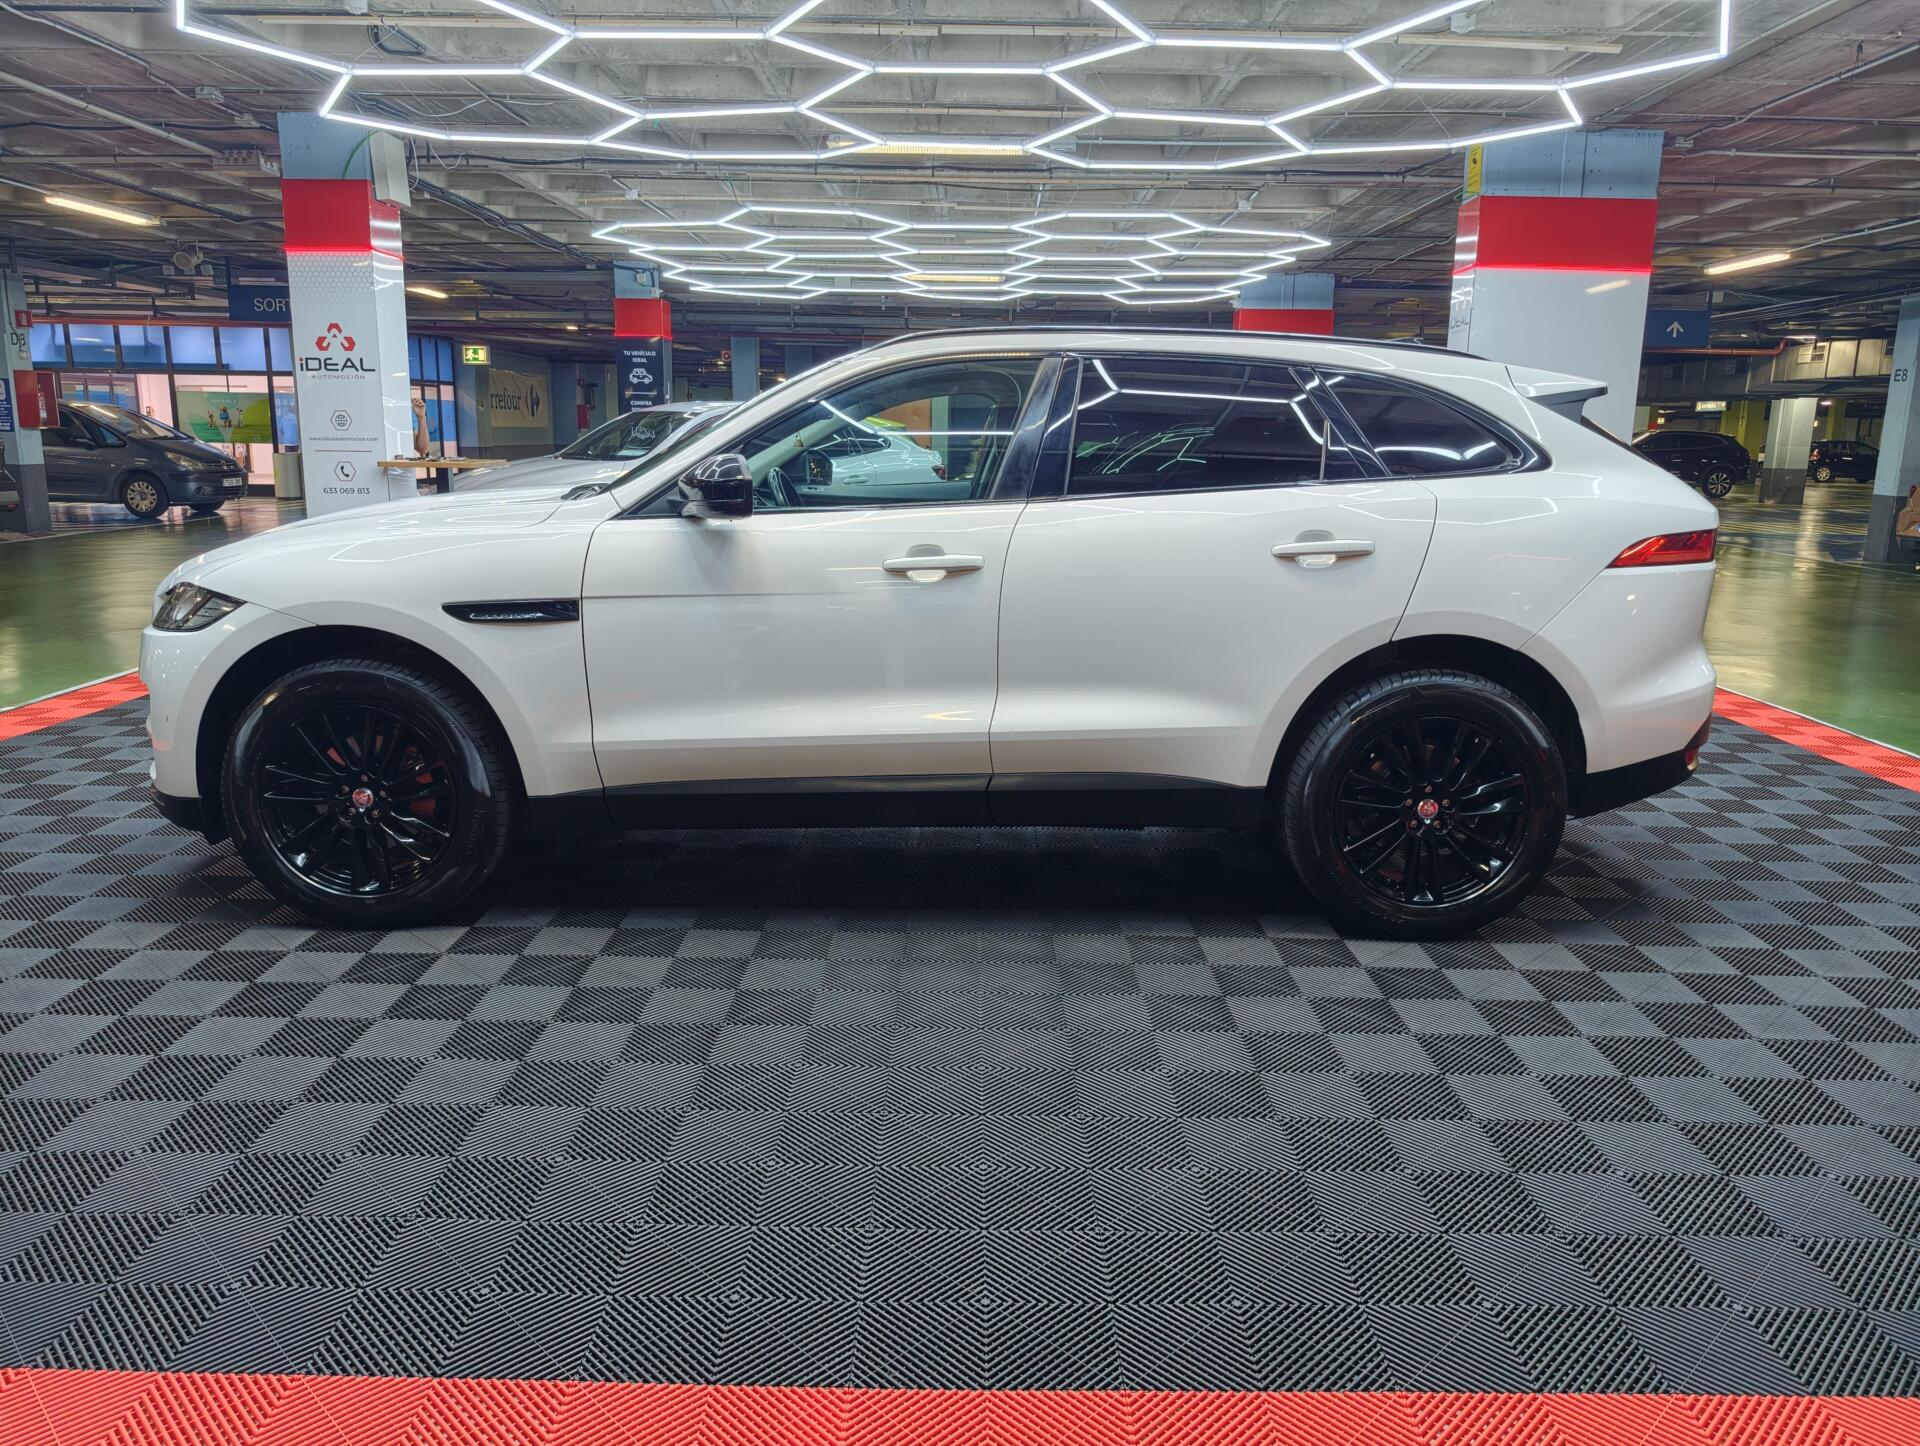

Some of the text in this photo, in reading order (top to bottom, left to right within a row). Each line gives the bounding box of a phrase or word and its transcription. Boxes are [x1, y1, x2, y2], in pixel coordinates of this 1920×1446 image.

[1893, 368, 1909, 382] E8
[323, 487, 371, 495] 633 069 813
